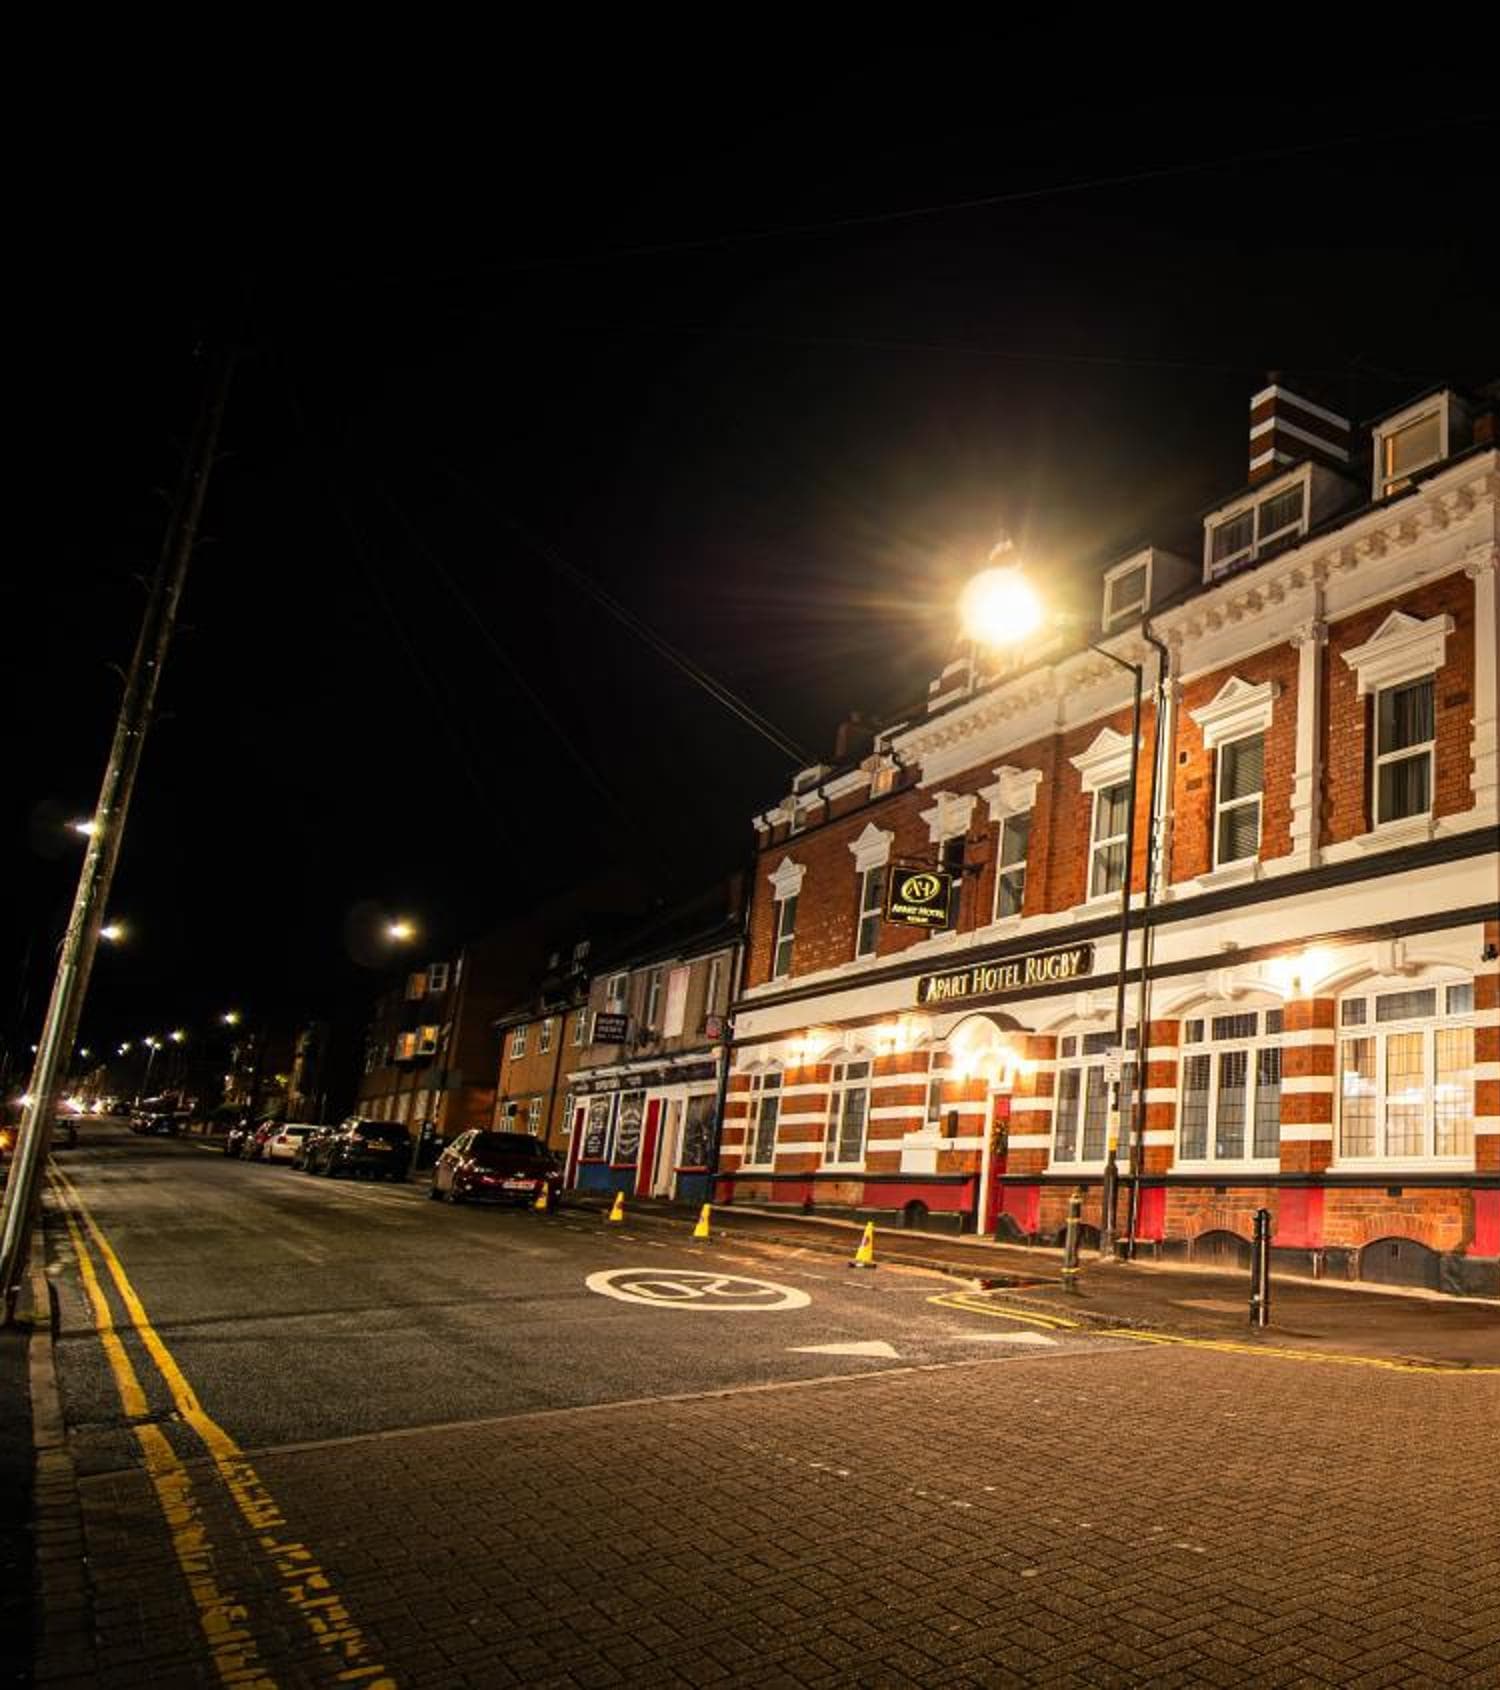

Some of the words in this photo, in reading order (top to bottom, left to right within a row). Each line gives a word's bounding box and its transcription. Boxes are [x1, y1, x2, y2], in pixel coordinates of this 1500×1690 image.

[926, 973, 971, 1001] APART
[972, 963, 1021, 993] HOTEL
[1025, 951, 1081, 984] RUGBY
